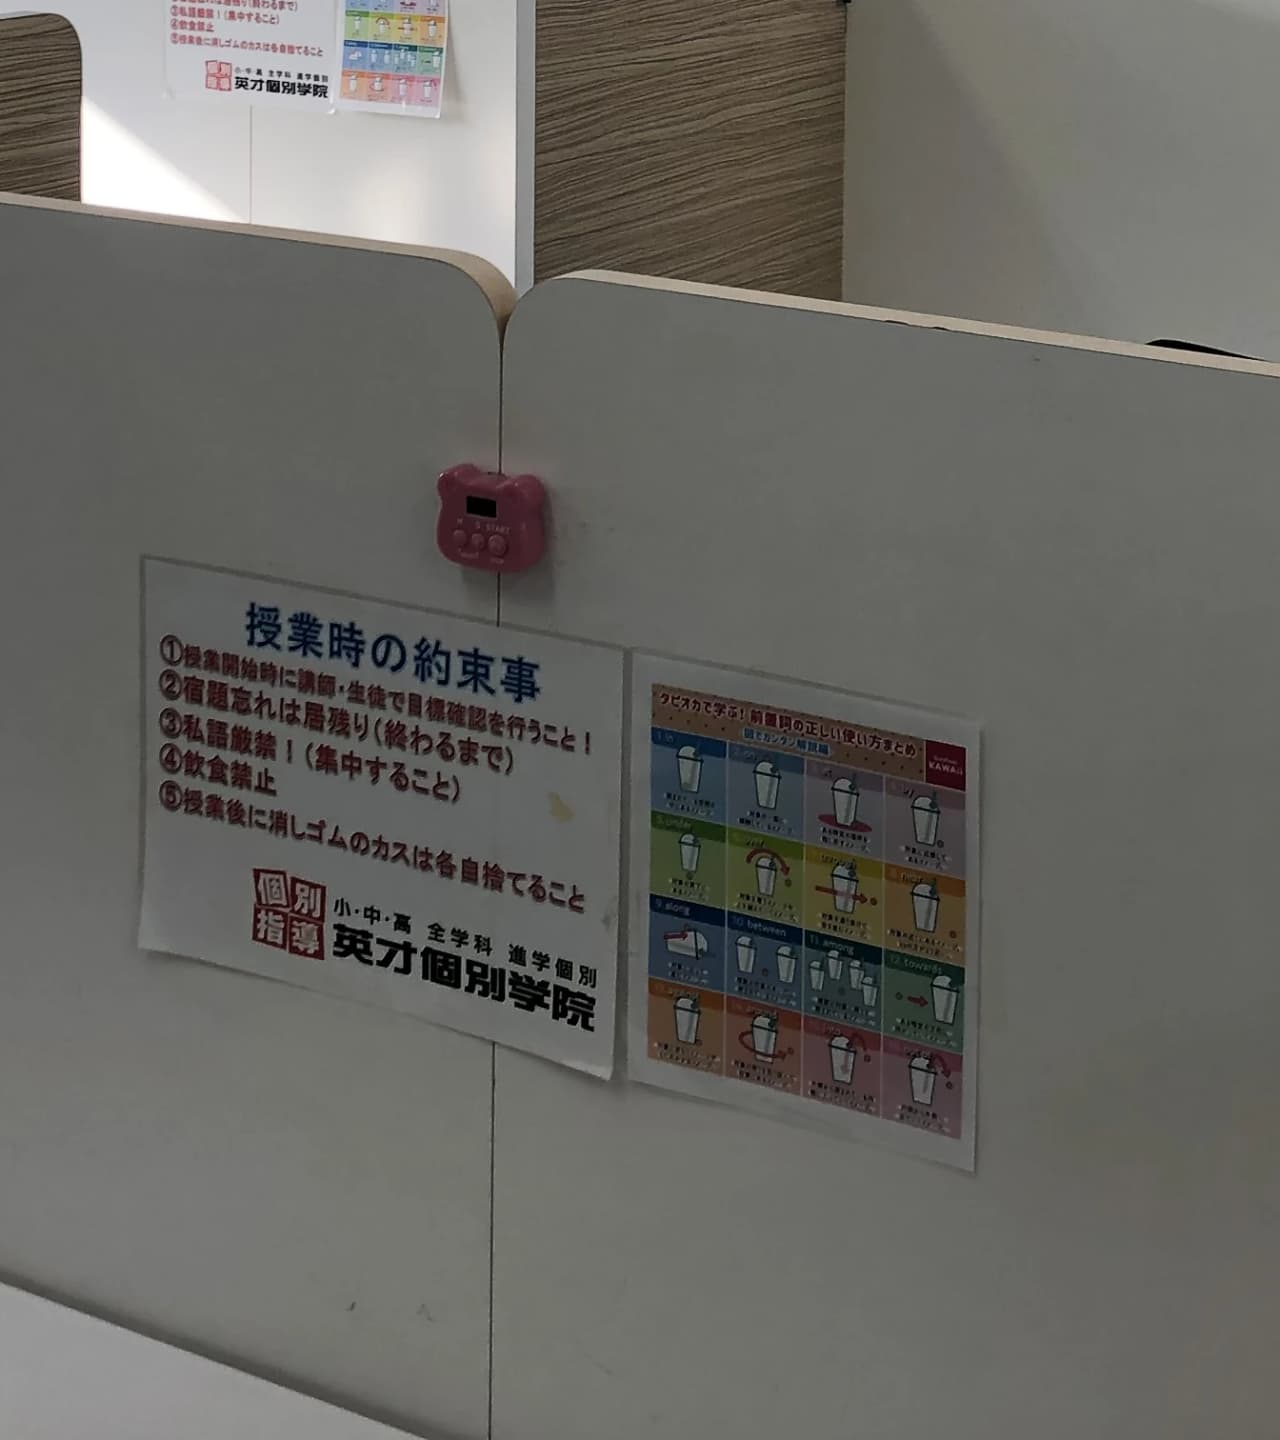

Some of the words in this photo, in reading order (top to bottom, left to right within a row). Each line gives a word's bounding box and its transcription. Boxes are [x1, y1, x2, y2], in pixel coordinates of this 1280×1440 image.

[234, 76, 329, 98] 英才個別学院
[246, 601, 541, 704] 授業時の約束事
[159, 743, 278, 797] ④飲食禁止
[256, 871, 324, 919] 個別
[256, 910, 323, 957] 指導
[332, 922, 598, 1033] 英才個別学院
